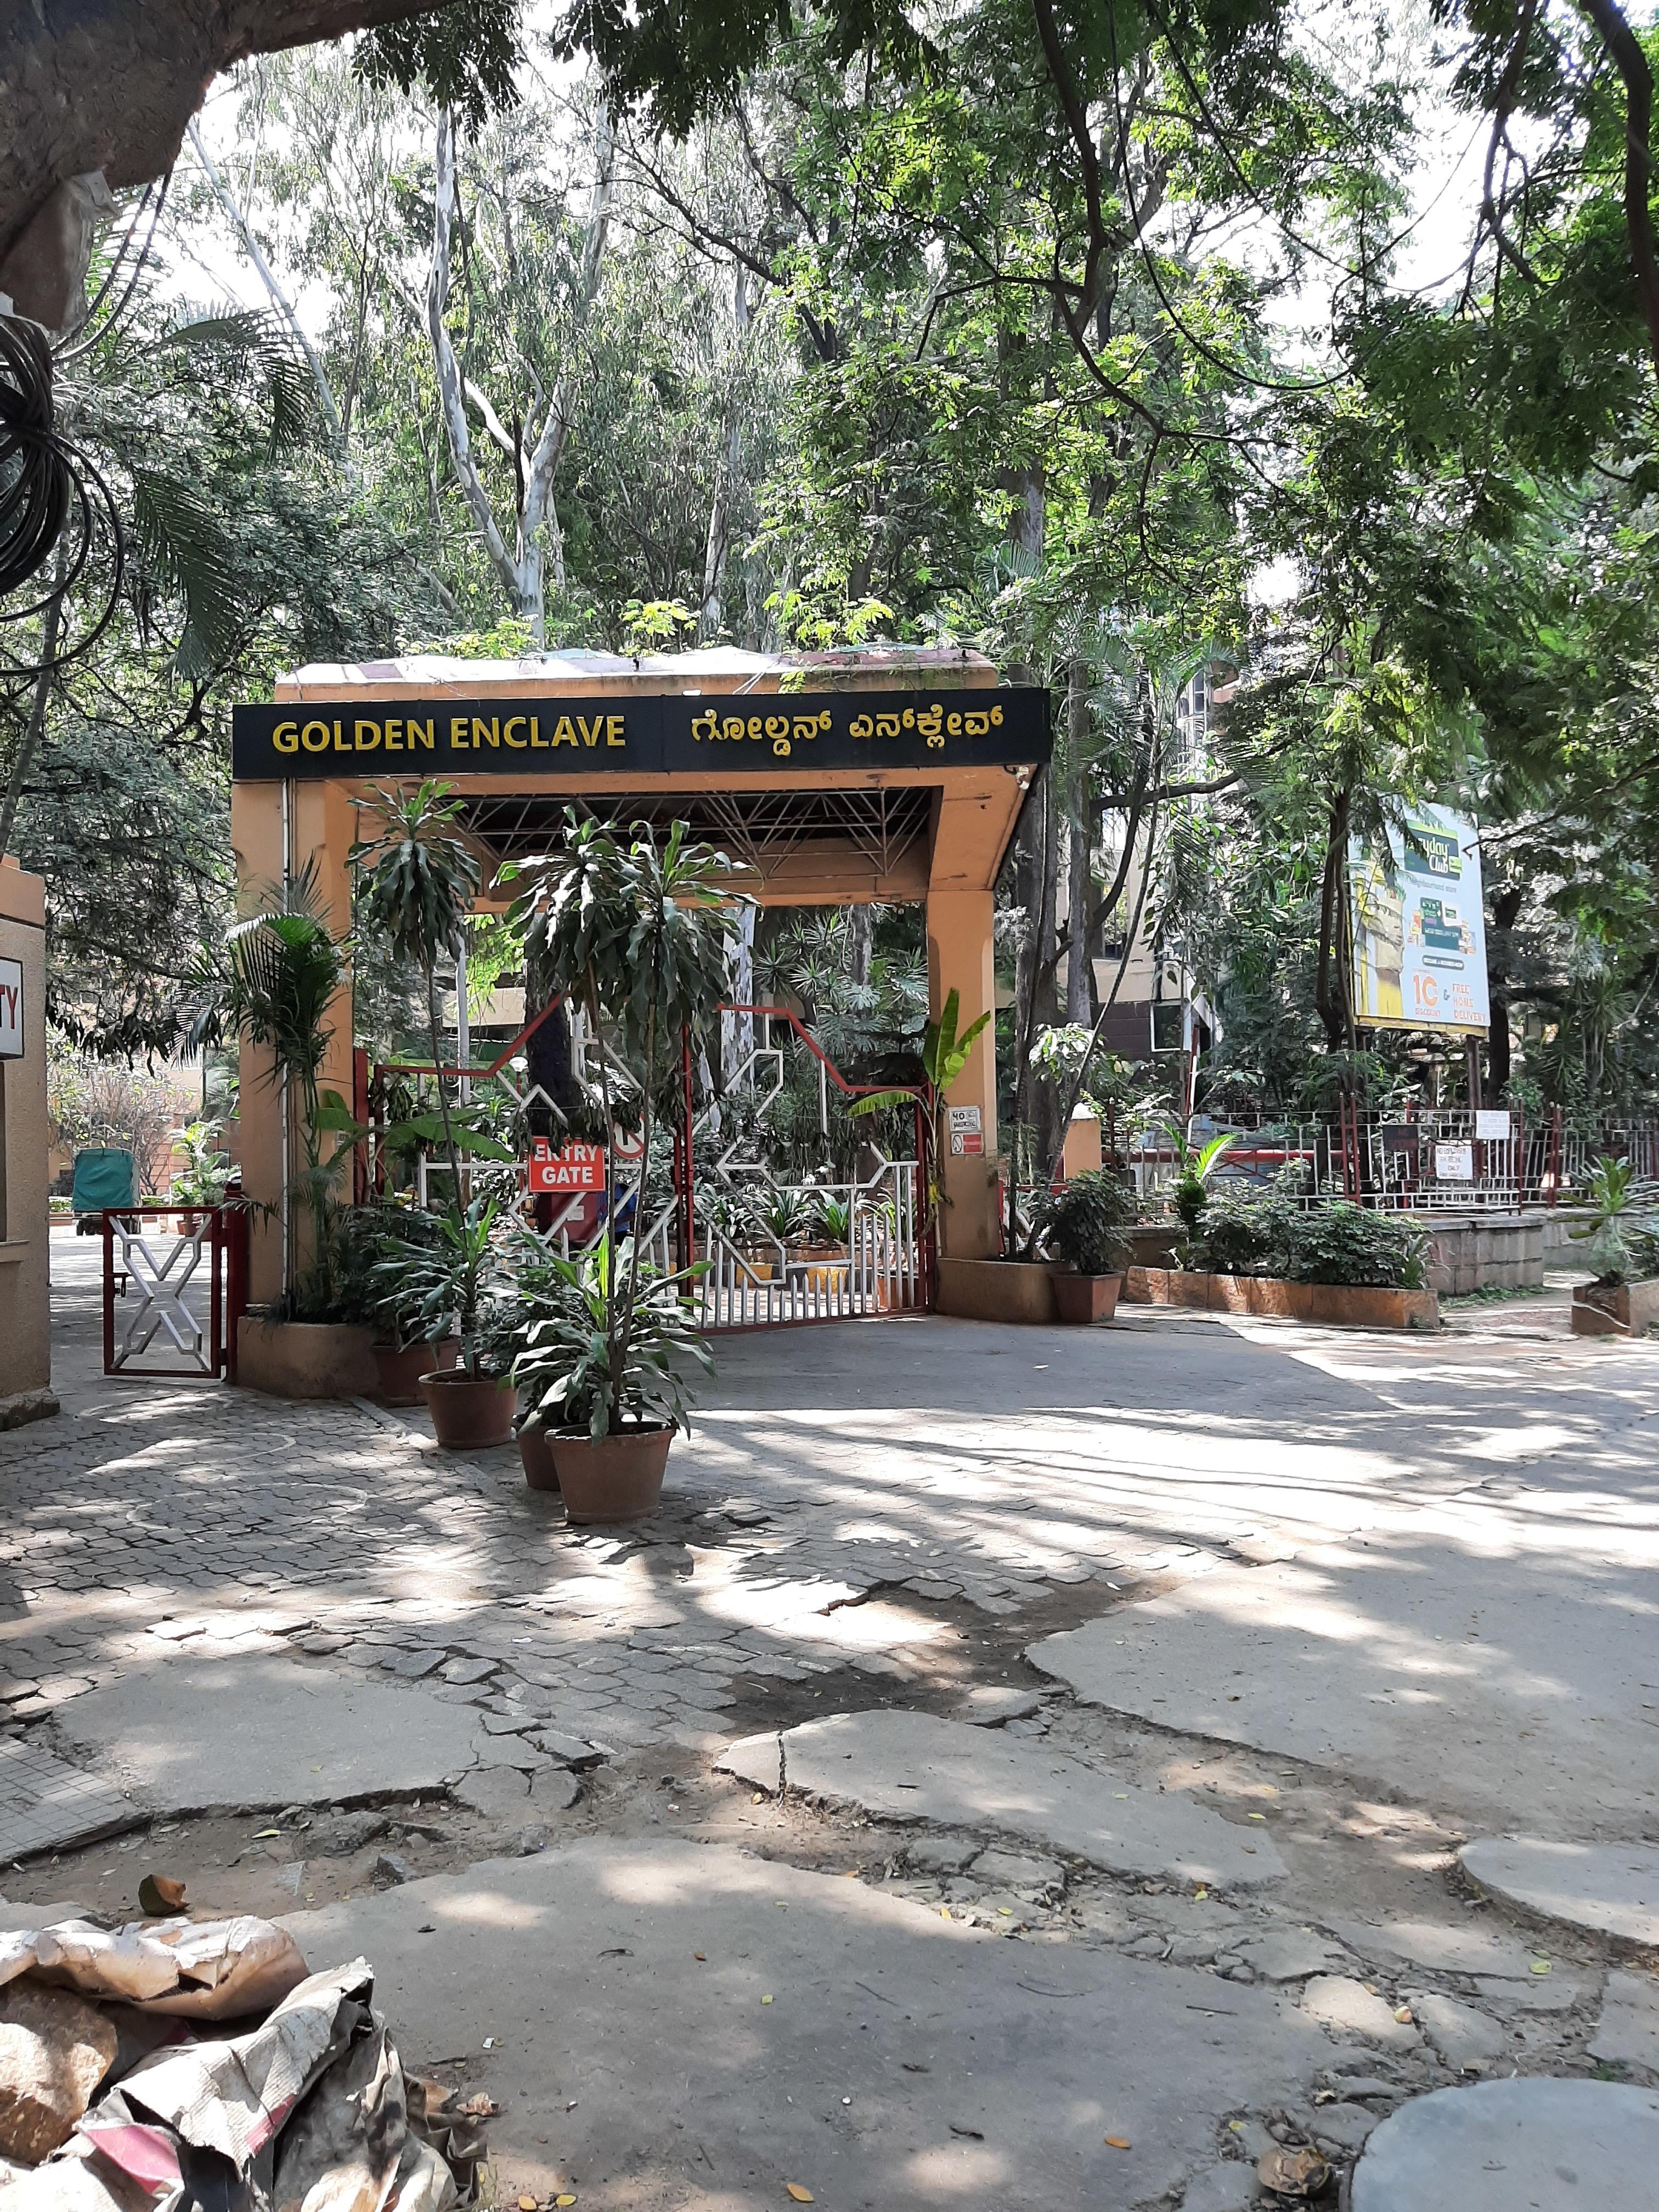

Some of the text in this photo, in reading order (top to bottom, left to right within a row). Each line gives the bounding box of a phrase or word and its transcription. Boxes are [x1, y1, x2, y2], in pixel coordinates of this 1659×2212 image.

[273, 715, 627, 753] GOLDEN ENCLAVE
[691, 708, 832, 756] ಗೋಲ್ಡನ್
[1429, 854, 1448, 873] Club
[1453, 983, 1470, 994] FREE
[1453, 997, 1473, 1007] HOME
[1454, 1009, 1485, 1023] DELIVERY
[534, 1144, 598, 1161] ENTRY
[542, 1166, 593, 1184] GATE
